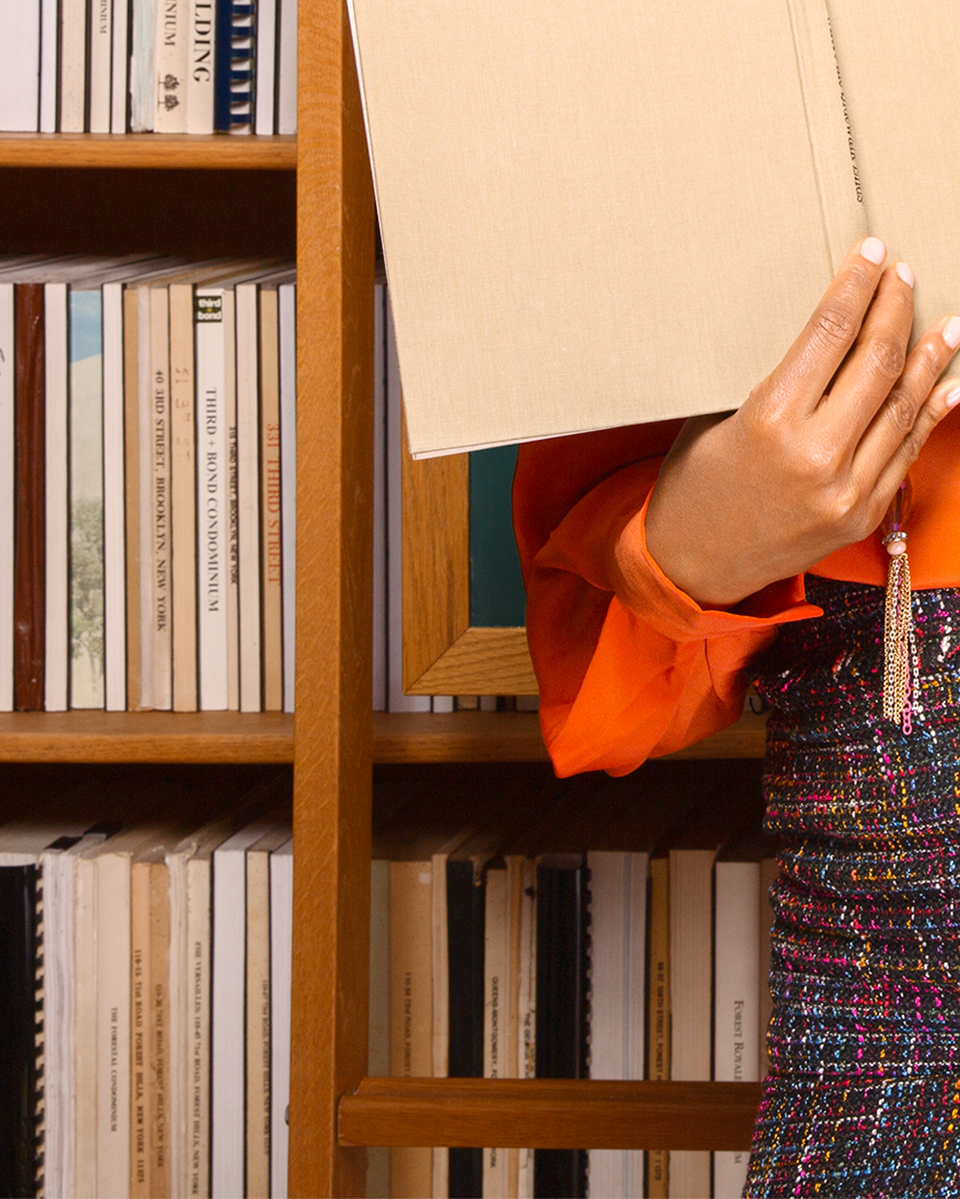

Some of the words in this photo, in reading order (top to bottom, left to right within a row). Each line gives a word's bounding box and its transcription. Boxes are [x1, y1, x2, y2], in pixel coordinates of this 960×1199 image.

[198, 311, 221, 320] bond
[199, 298, 221, 308] third
[155, 370, 164, 384] 40
[155, 388, 165, 415] 3RD
[206, 387, 217, 435] THIRD
[155, 418, 165, 472] STREET,
[267, 423, 279, 448] 331
[206, 452, 217, 494] BOND
[267, 458, 280, 513] THIRD
[155, 477, 166, 555] BROOKLYN,
[207, 498, 219, 612] CONDOMINIUM
[268, 519, 281, 587] STREET
[156, 559, 166, 591] NEW
[157, 596, 166, 632] YORK
[135, 1001, 143, 1028] ROAD
[135, 1032, 143, 1066] FOREST
[136, 1105, 144, 1124] NEW
[136, 1128, 144, 1153] YORK
[192, 1172, 200, 1195] YORK
